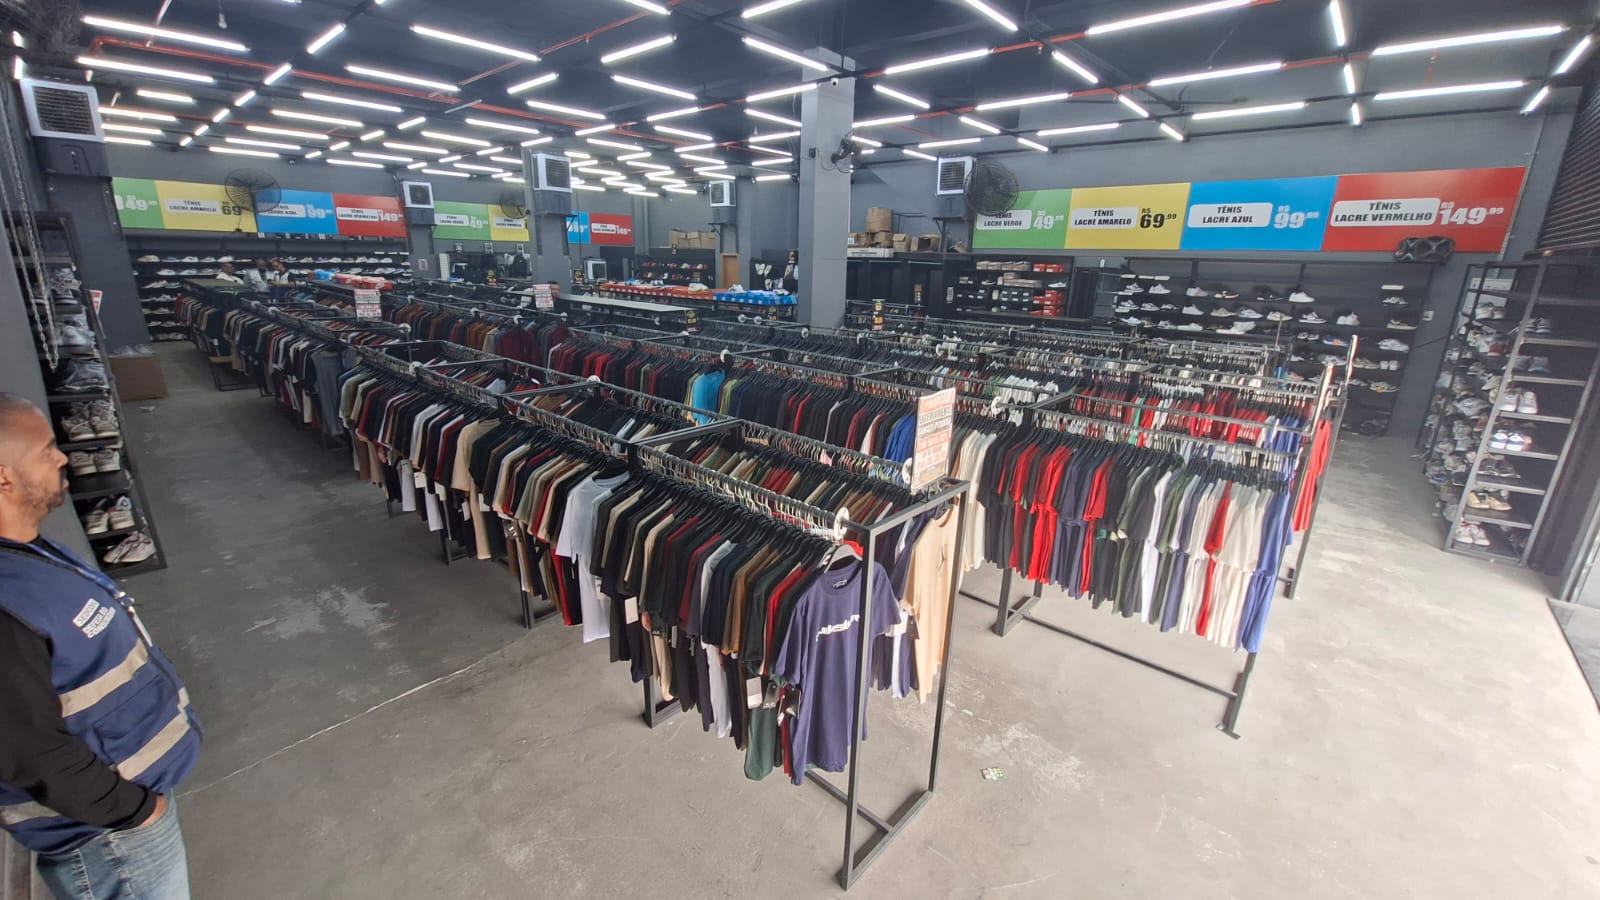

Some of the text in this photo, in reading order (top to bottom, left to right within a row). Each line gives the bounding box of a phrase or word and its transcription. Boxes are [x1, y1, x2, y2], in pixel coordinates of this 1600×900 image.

[1369, 201, 1401, 211] TÊNIS
[1231, 215, 1253, 223] AZUL
[1334, 212, 1433, 222] LACRE VERMELHO
[1074, 218, 1132, 226] LACRE AMARELO
